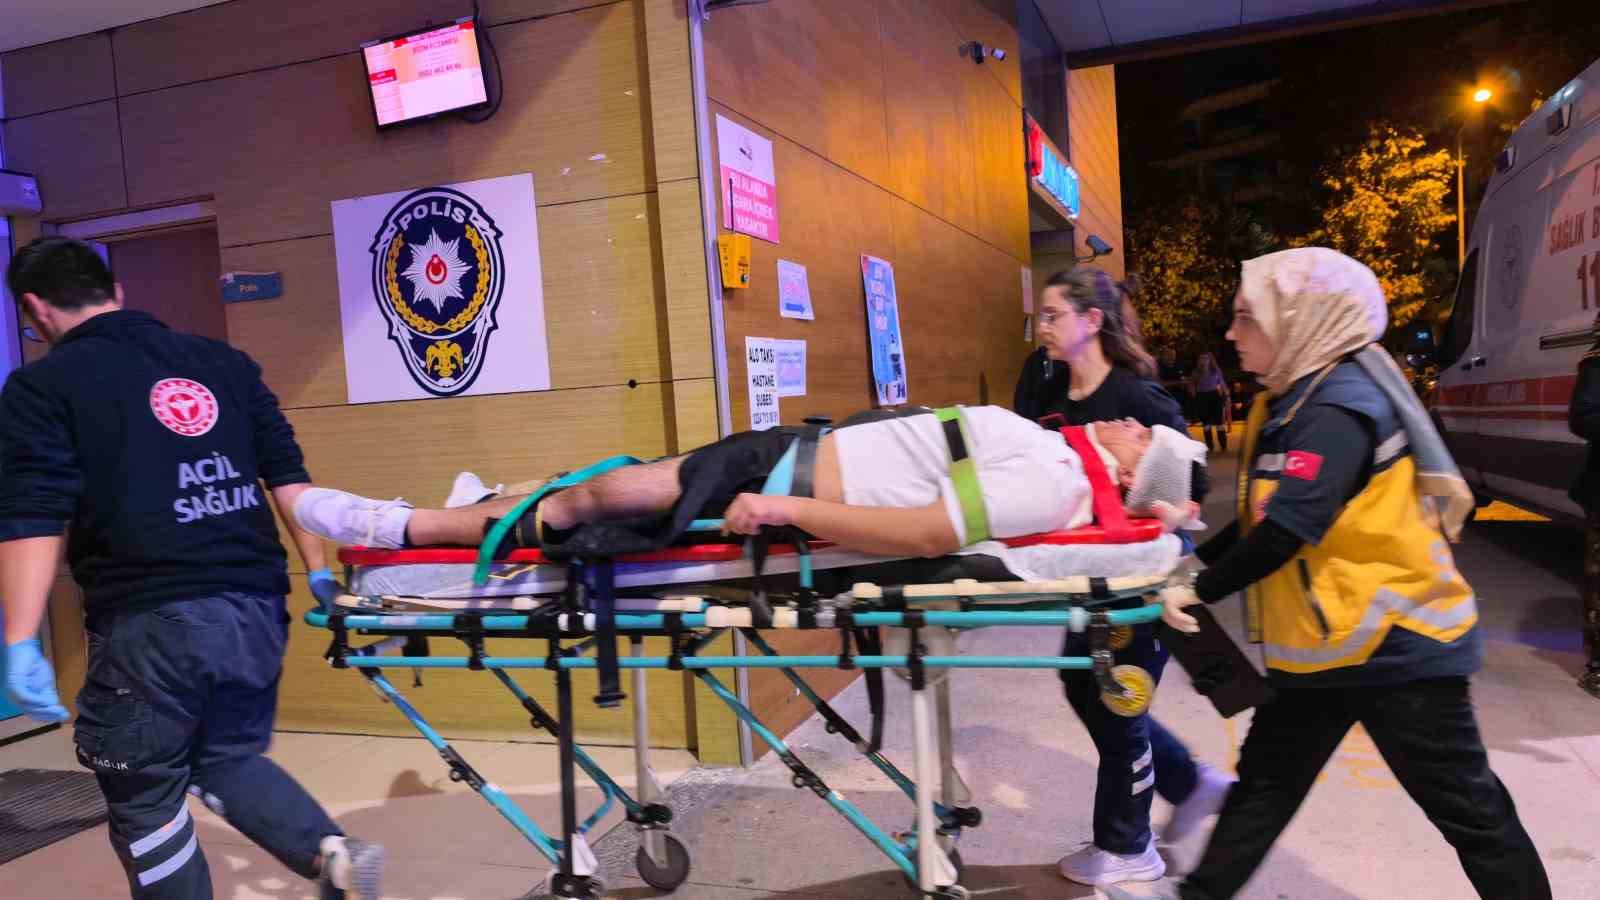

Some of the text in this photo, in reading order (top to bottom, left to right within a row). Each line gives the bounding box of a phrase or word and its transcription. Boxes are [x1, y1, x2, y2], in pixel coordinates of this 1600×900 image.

[399, 199, 466, 231] POLİS
[752, 375, 775, 388] HASTANE
[179, 451, 241, 489] ACİL
[173, 484, 259, 523] SAĞLIK
